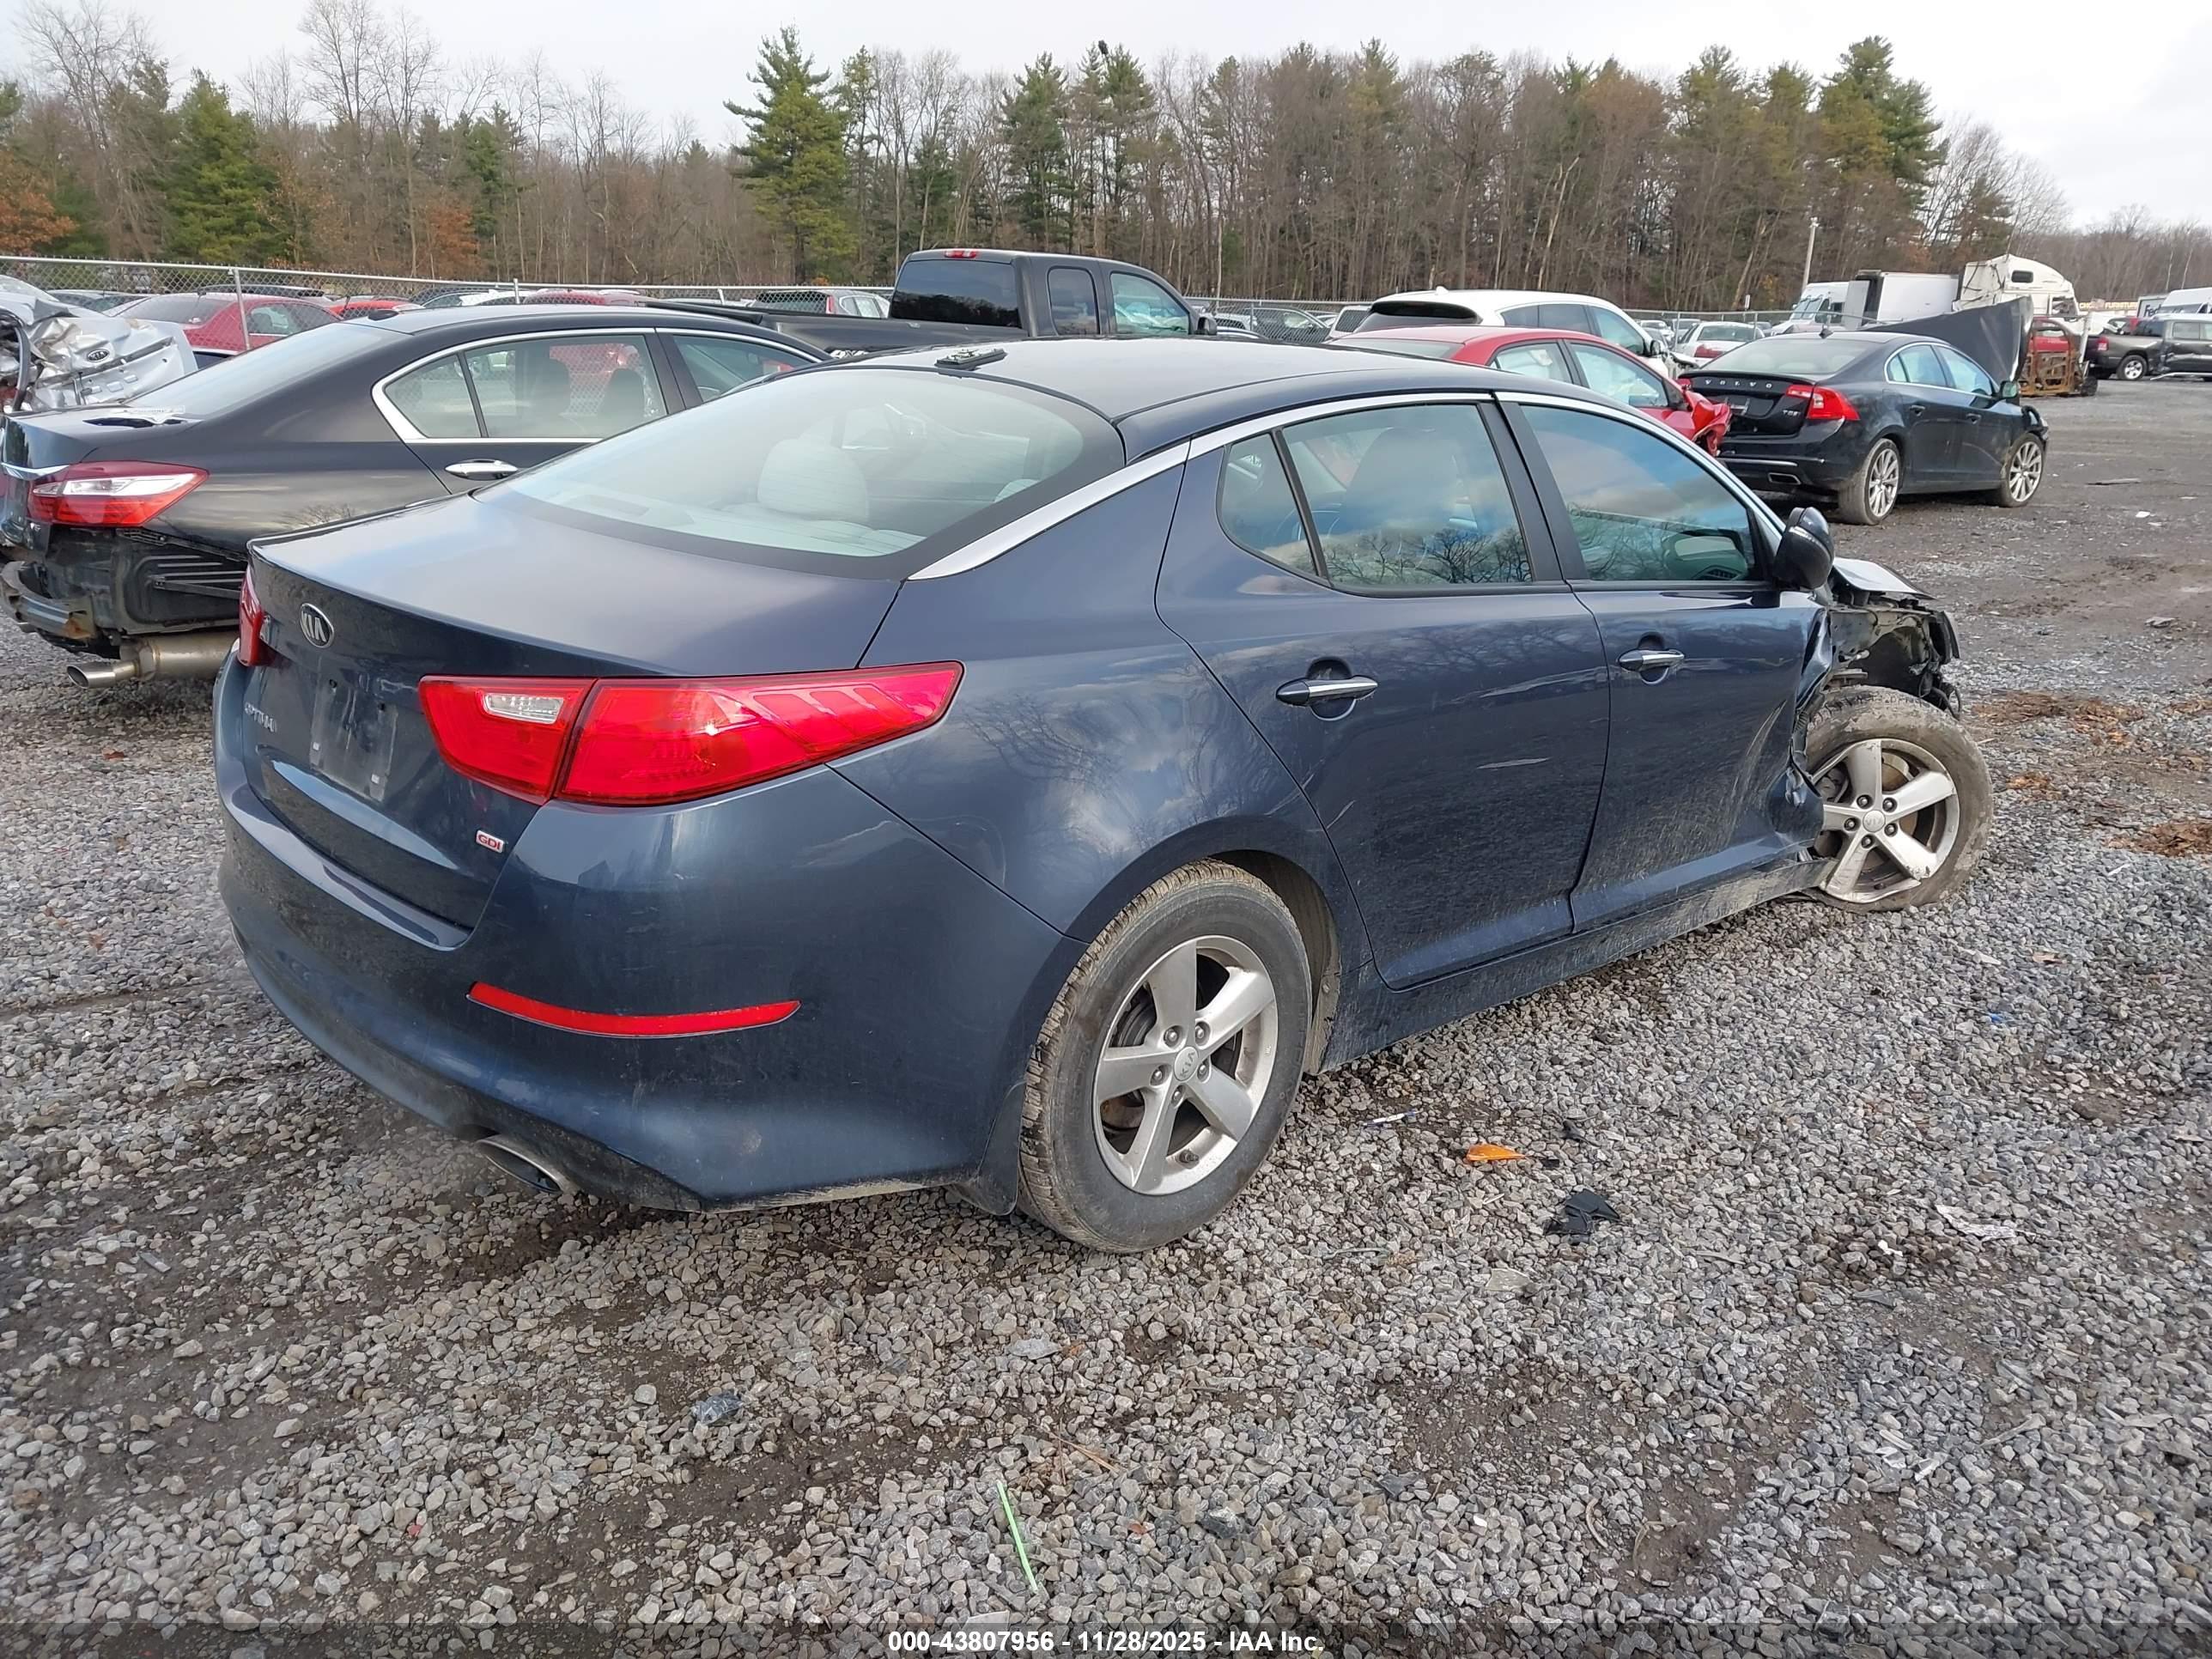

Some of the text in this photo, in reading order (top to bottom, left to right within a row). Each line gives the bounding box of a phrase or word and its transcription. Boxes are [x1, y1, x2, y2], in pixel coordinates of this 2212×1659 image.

[1705, 379, 1772, 389] VOLVO
[301, 611, 327, 642] KIA
[478, 834, 501, 850] GDI
[1179, 1051, 1196, 1078] KIA
